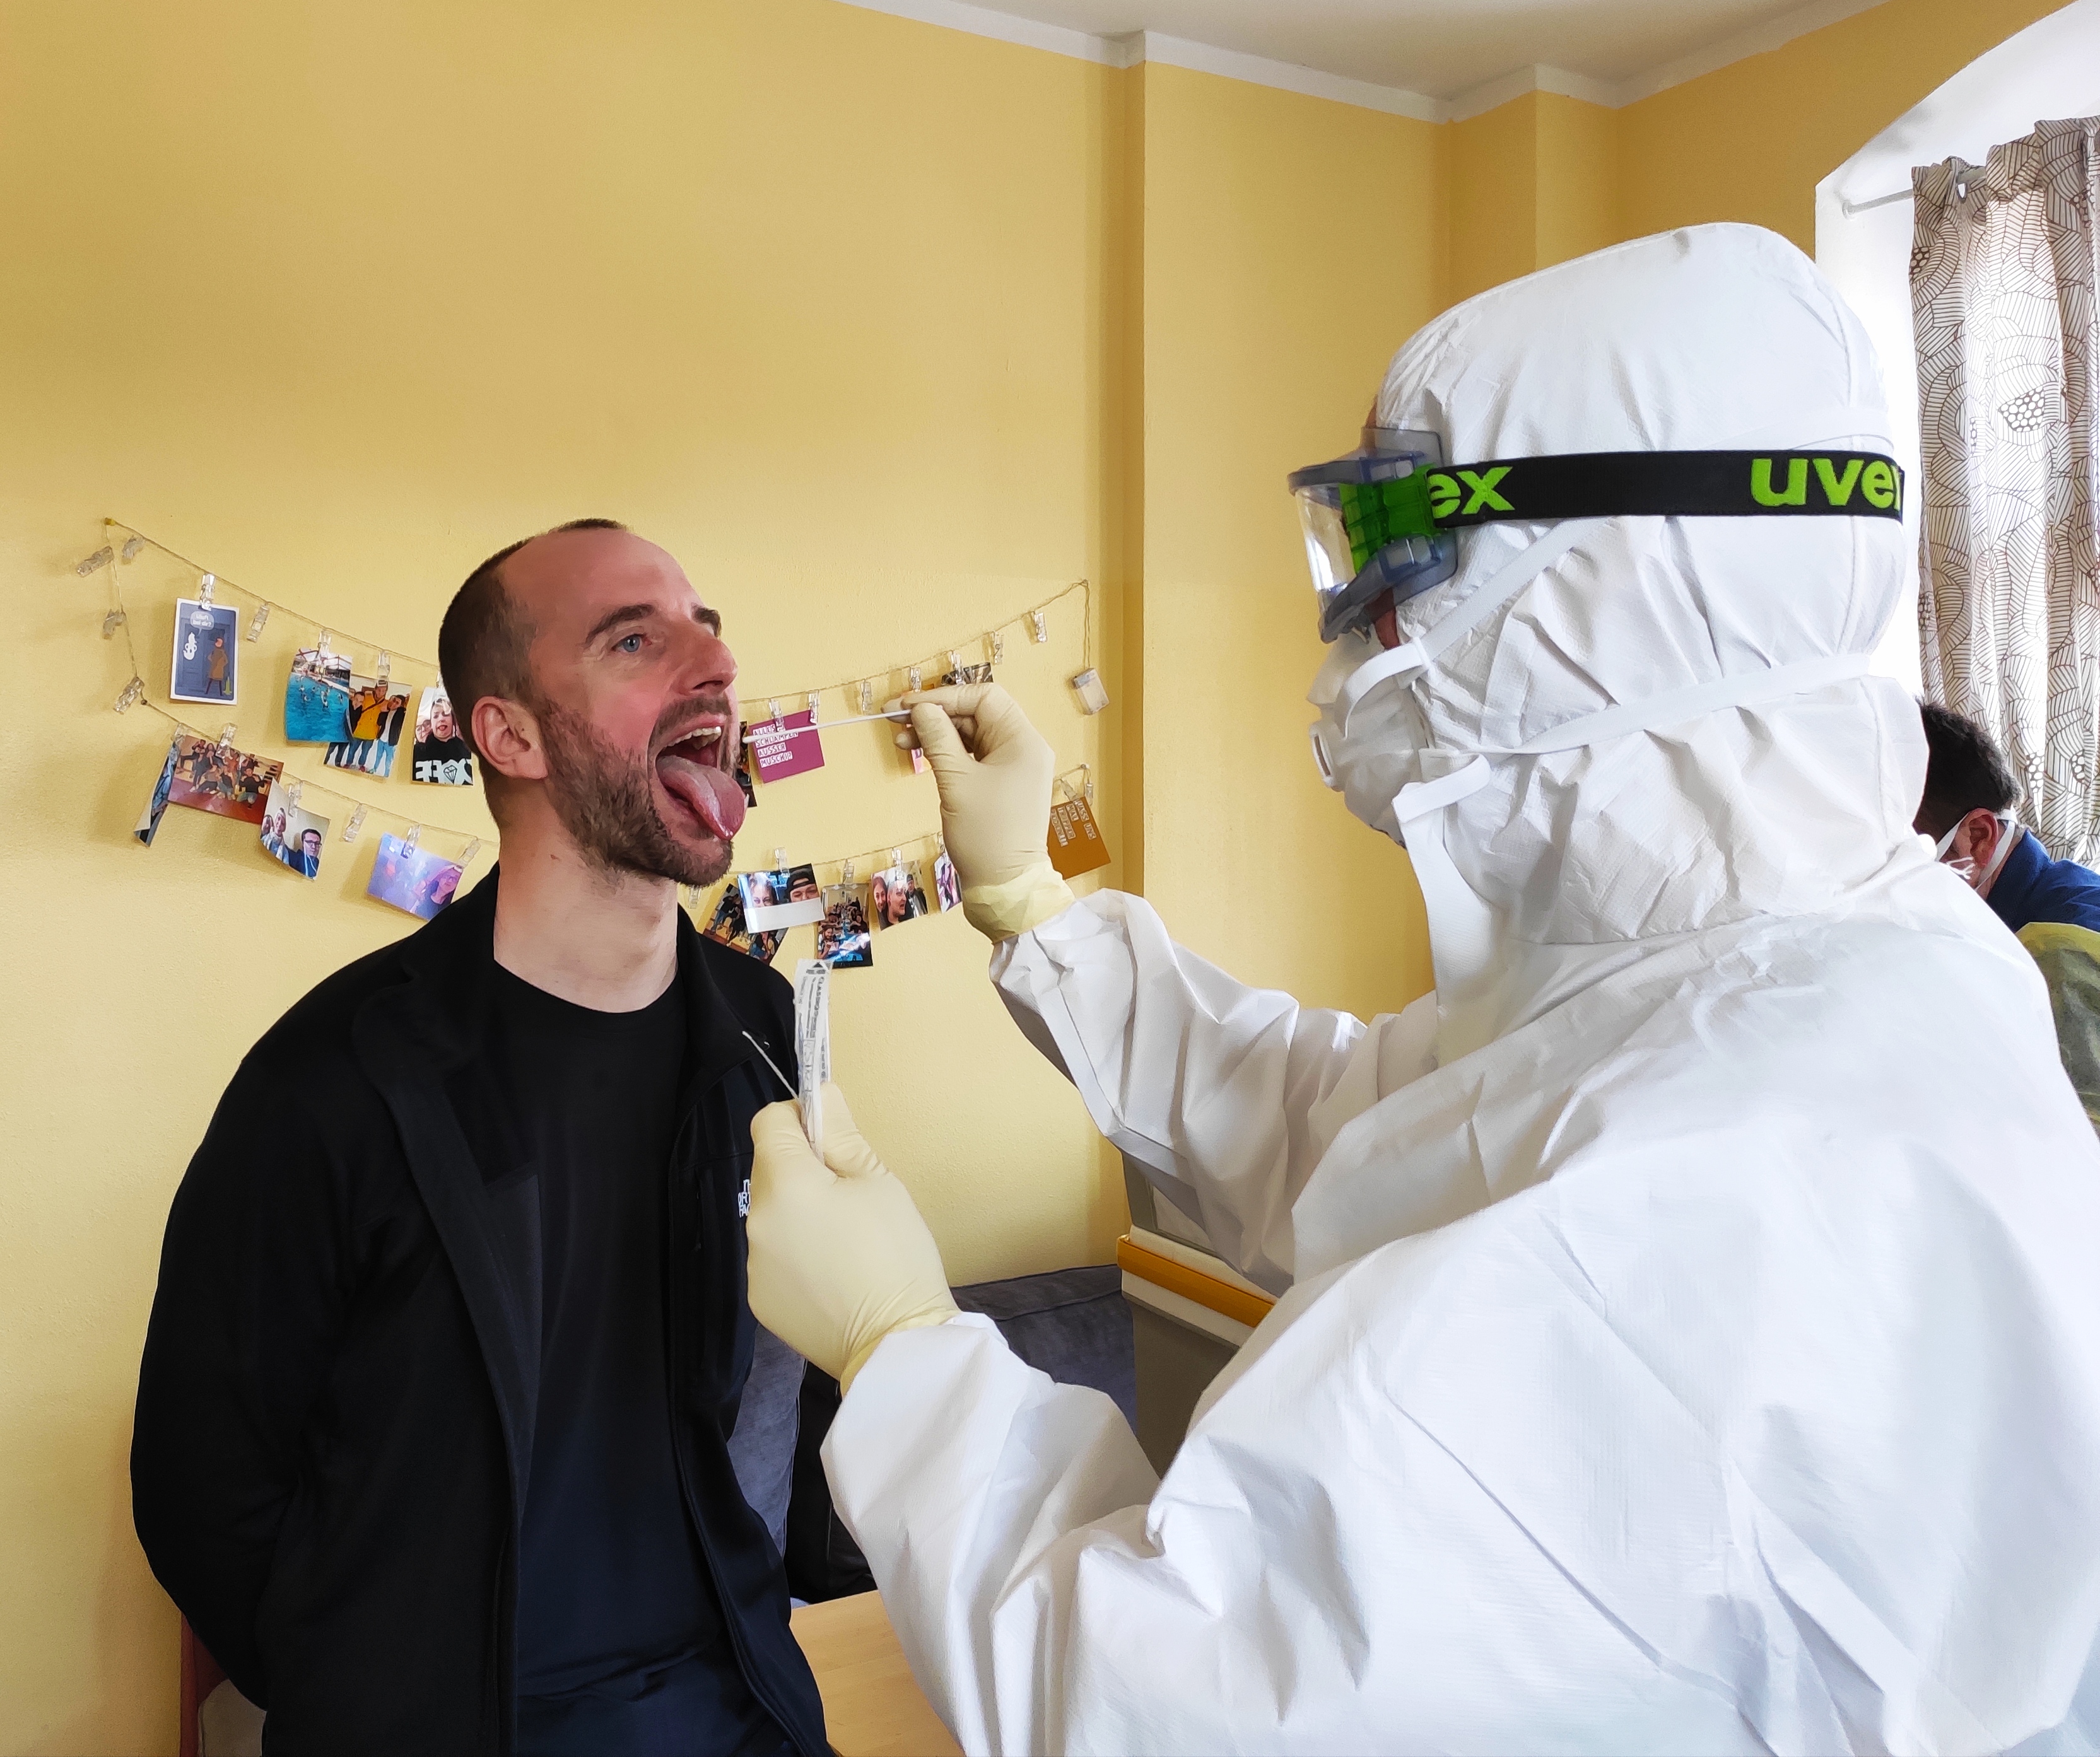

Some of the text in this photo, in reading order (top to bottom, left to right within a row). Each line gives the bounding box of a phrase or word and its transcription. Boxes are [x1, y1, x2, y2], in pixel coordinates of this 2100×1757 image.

[1427, 466, 1515, 519] ex
[753, 724, 776, 737] ALLES
[758, 743, 786, 757] AUSSER
[1066, 803, 1079, 821] MAL
[1084, 823, 1096, 839] UNS
